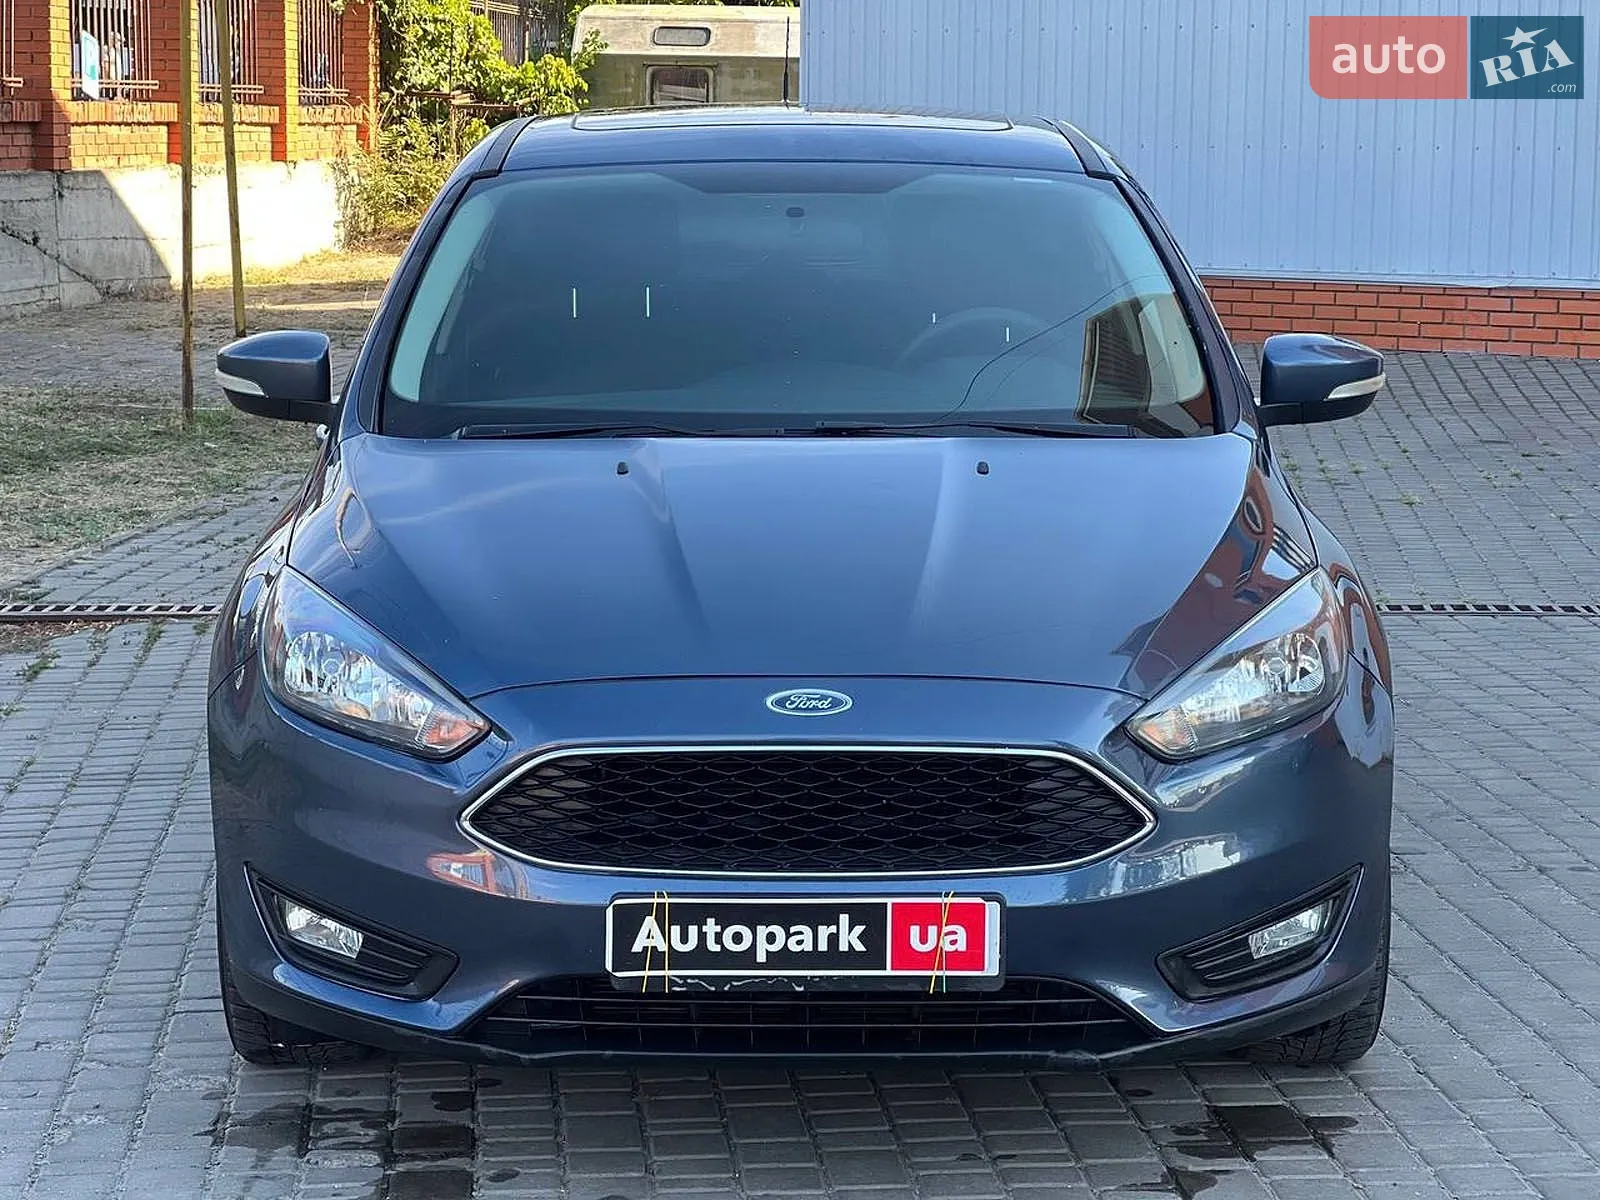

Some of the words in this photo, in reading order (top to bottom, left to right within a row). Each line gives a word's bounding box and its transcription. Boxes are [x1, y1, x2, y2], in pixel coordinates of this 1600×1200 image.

[785, 694, 833, 709] Ford
[630, 913, 867, 963] Autopark
[908, 924, 967, 953] ua
